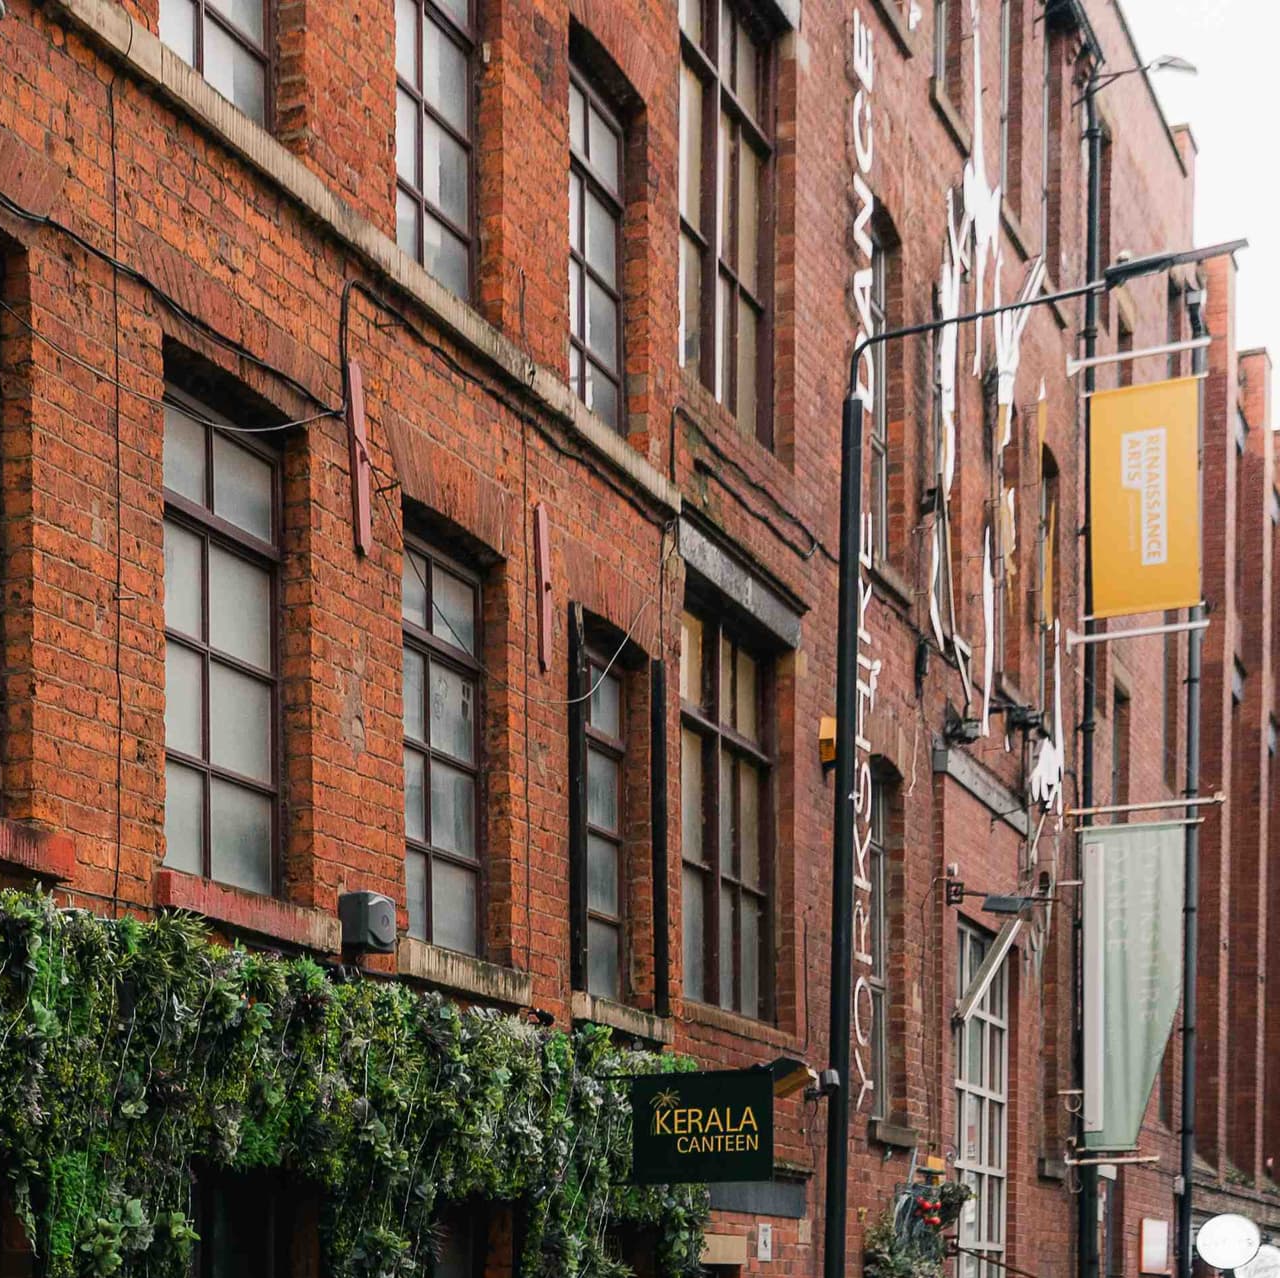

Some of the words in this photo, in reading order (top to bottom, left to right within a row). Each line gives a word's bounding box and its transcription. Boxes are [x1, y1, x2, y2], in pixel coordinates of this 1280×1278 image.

[853, 8, 874, 413] DANCE
[1127, 439, 1141, 482] ARTS
[1146, 434, 1161, 559] RENAISSANCE
[1108, 847, 1128, 952] DANCE
[656, 1106, 758, 1135] KERALA
[677, 1134, 759, 1153] CANTEEN
